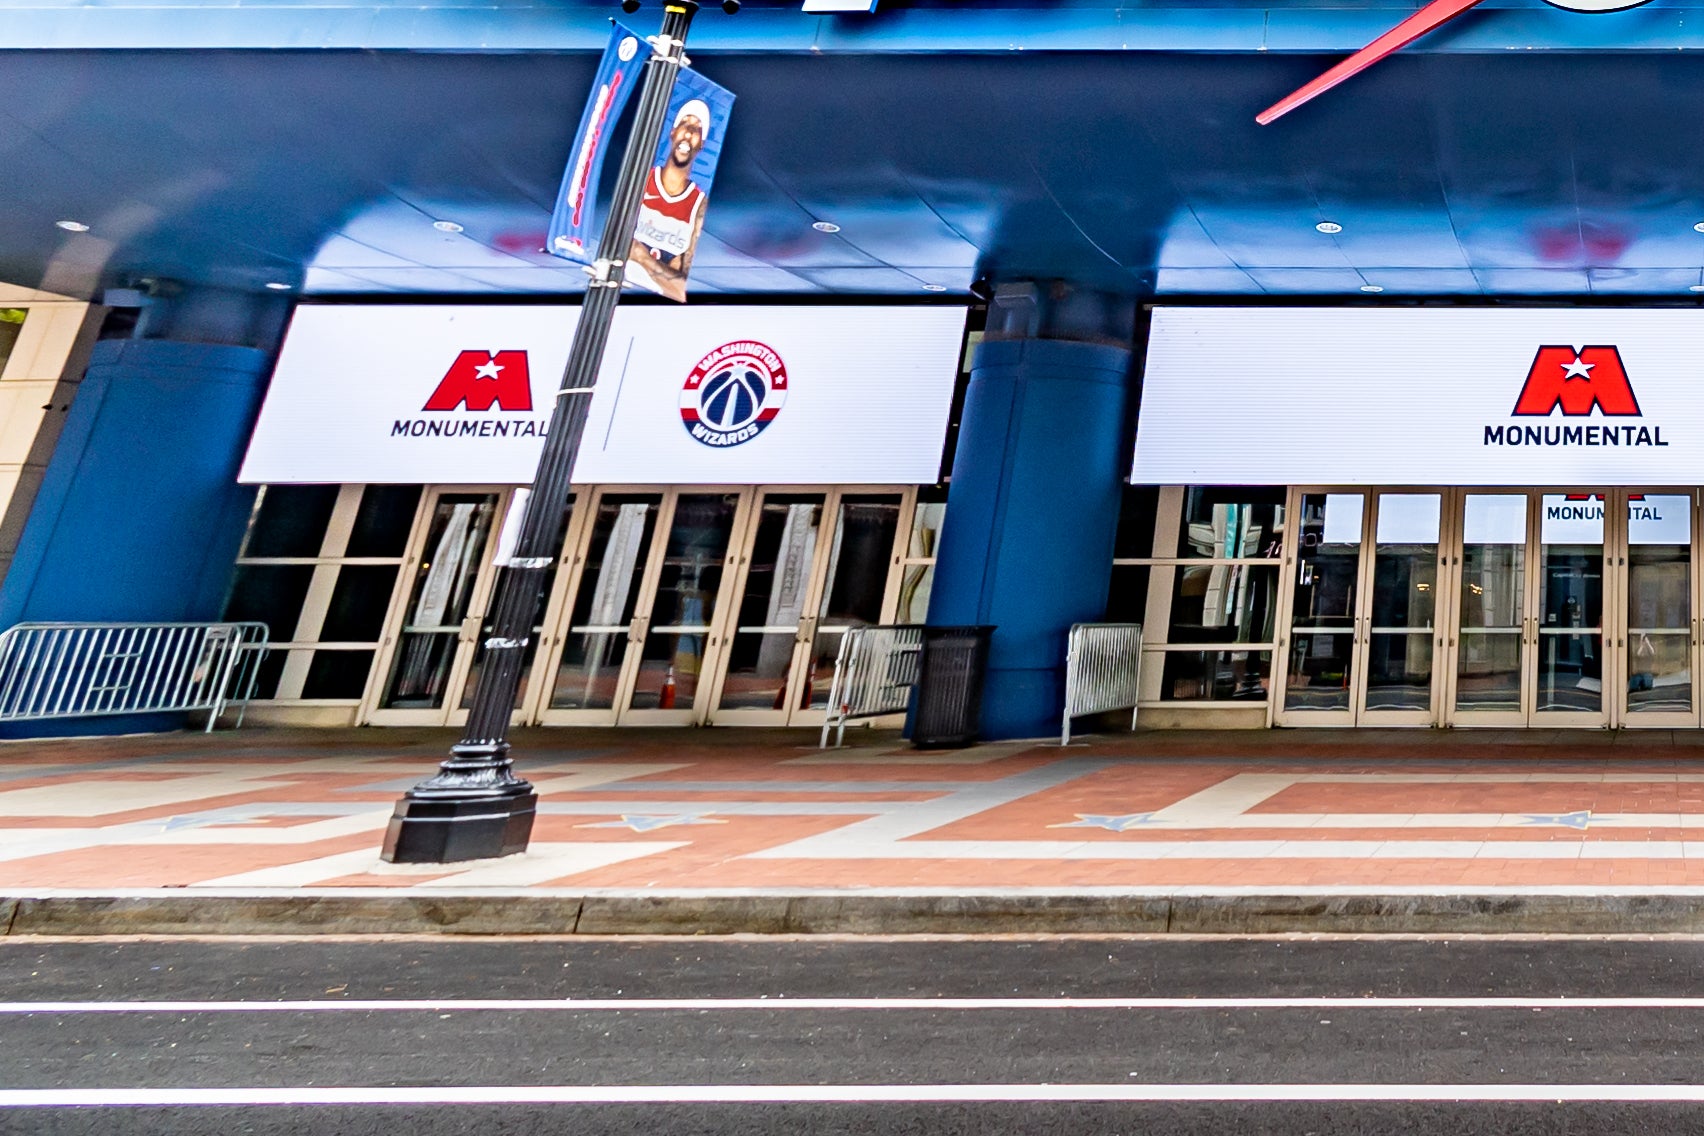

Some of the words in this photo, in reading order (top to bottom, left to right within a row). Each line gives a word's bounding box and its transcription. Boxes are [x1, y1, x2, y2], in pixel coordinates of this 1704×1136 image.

[697, 342, 783, 373] WASHINGTON
[391, 420, 550, 438] MONUMENTAL
[691, 423, 759, 446] WIZARDS
[1483, 425, 1669, 446] MONUMENTAL
